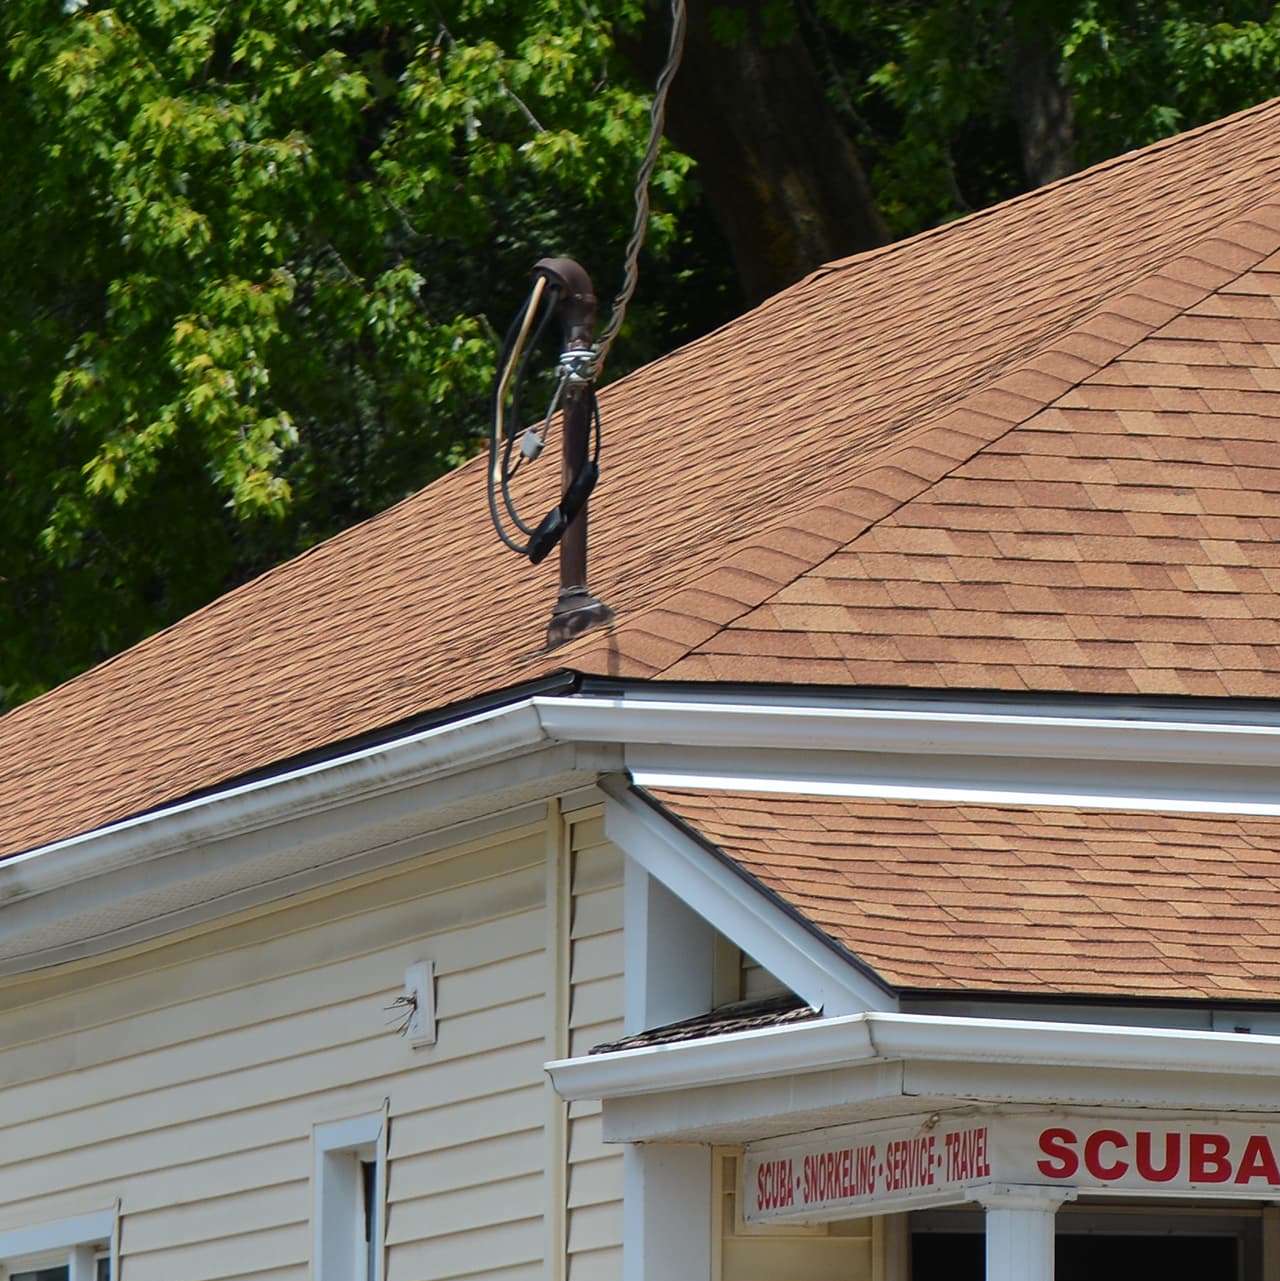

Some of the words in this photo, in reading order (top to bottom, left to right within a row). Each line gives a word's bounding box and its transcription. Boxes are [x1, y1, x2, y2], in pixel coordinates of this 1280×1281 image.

[756, 1158, 795, 1212] SCUBA
[803, 1144, 876, 1204] SNORKELING
[885, 1135, 936, 1192] SERVICE
[944, 1126, 991, 1183] TRAVEL
